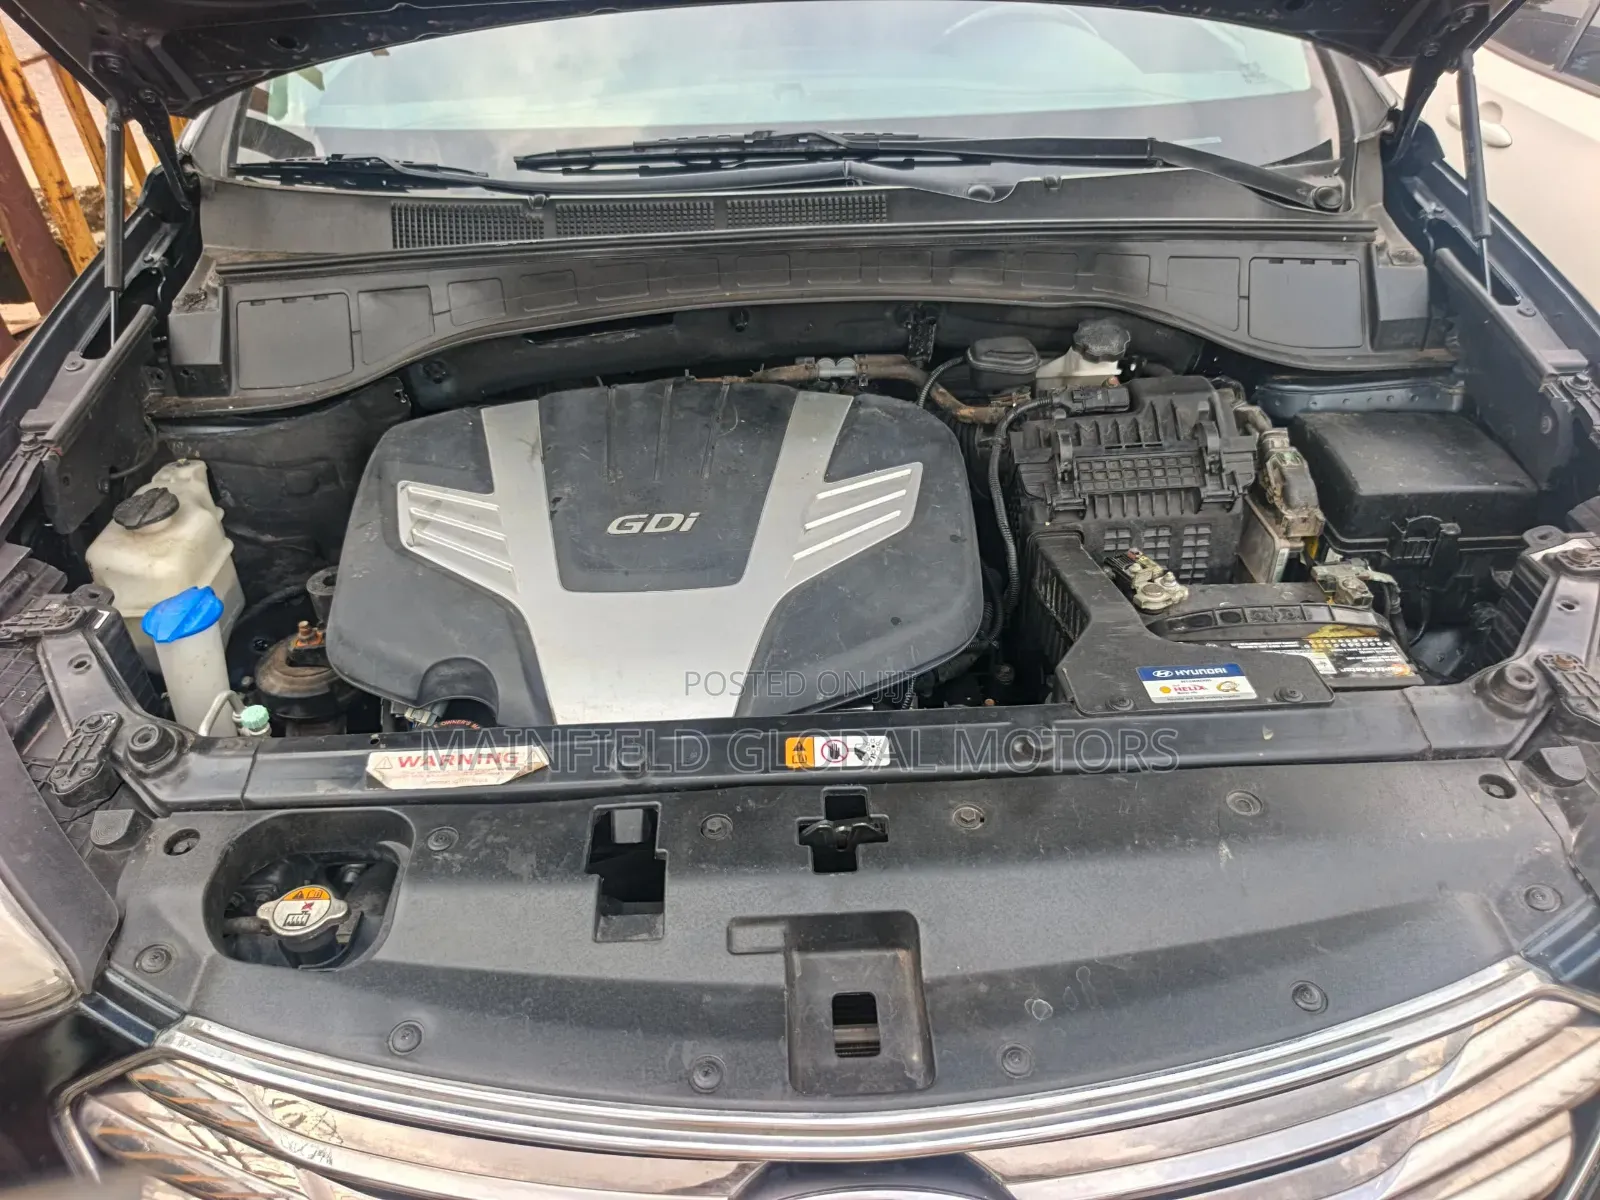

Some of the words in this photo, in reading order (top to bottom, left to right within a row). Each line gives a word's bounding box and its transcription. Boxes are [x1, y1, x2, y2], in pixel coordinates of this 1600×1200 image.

[607, 512, 700, 535] GDi
[1175, 667, 1228, 677] HYUNDAI
[397, 752, 519, 768] WARNING
